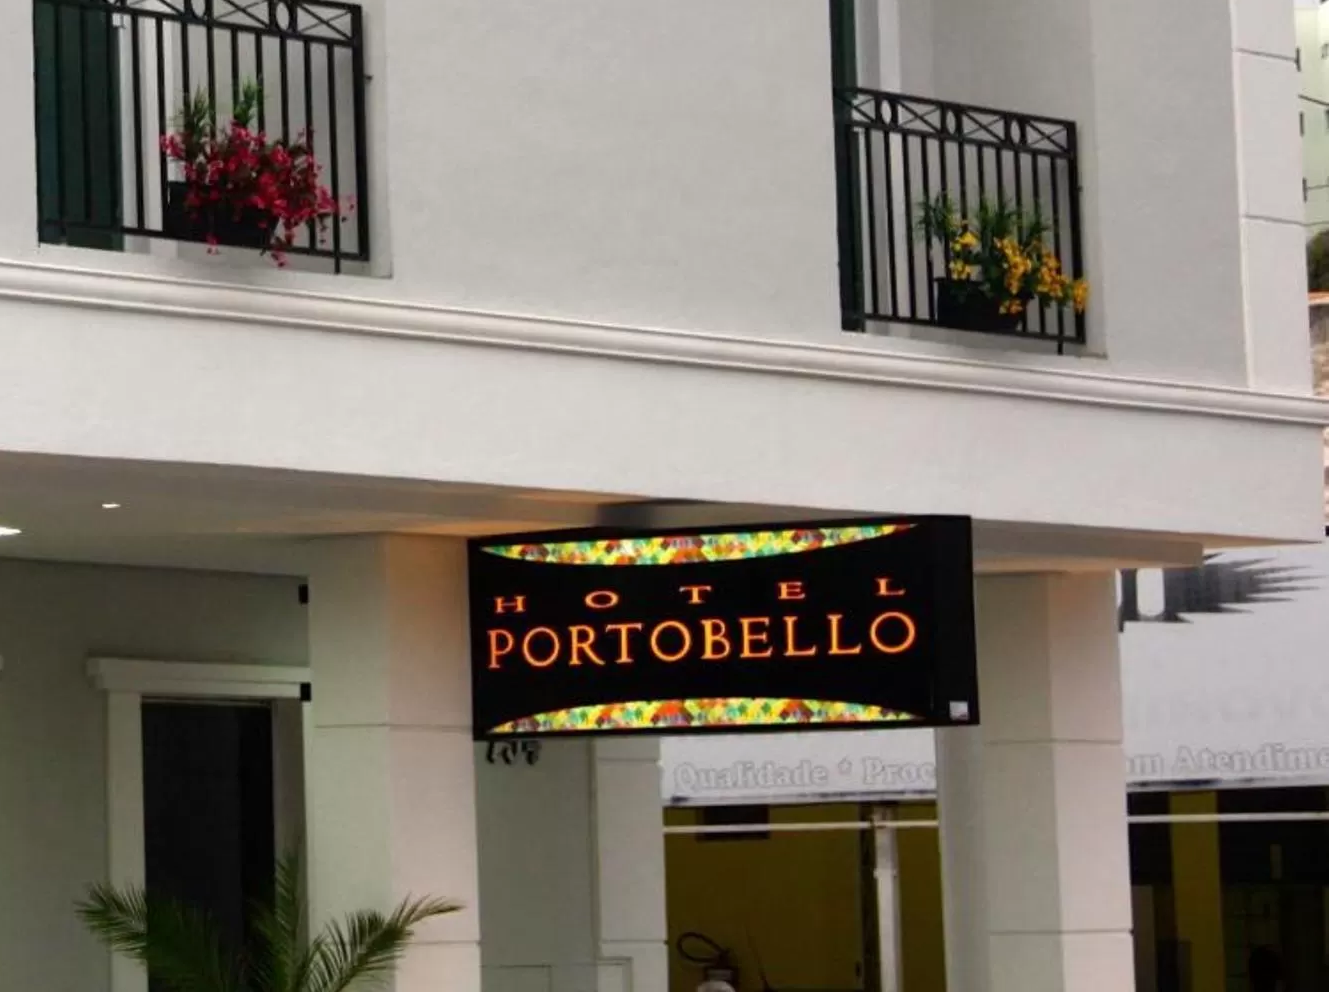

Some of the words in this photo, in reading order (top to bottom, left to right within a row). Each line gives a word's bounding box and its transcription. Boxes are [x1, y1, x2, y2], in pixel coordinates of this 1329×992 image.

[495, 577, 905, 613] HOTEL
[488, 611, 916, 669] PORTOBELLO
[673, 758, 829, 792] Qualidade
